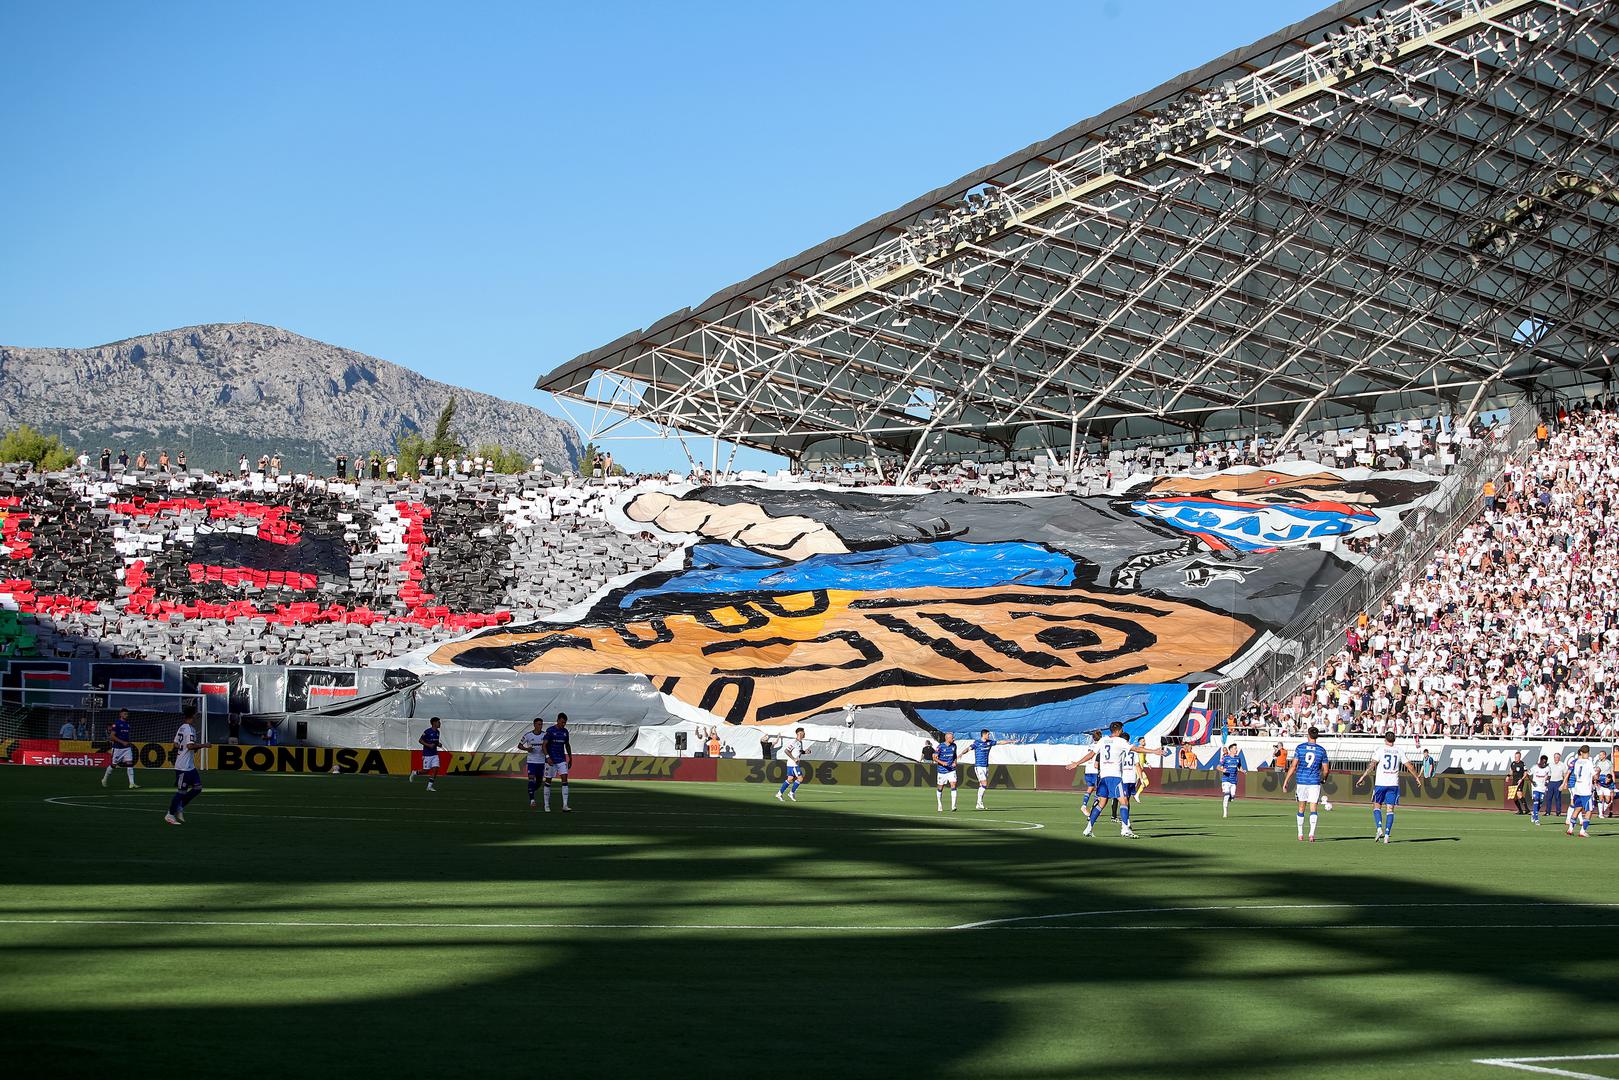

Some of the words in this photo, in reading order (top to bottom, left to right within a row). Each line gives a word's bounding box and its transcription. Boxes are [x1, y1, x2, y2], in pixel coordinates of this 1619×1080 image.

[43, 754, 94, 766] aircash
[218, 745, 389, 775] BONUSA
[447, 752, 528, 773] RIZK
[599, 756, 678, 777] RIZK
[1305, 752, 1315, 768] 9
[1383, 754, 1397, 770] 31
